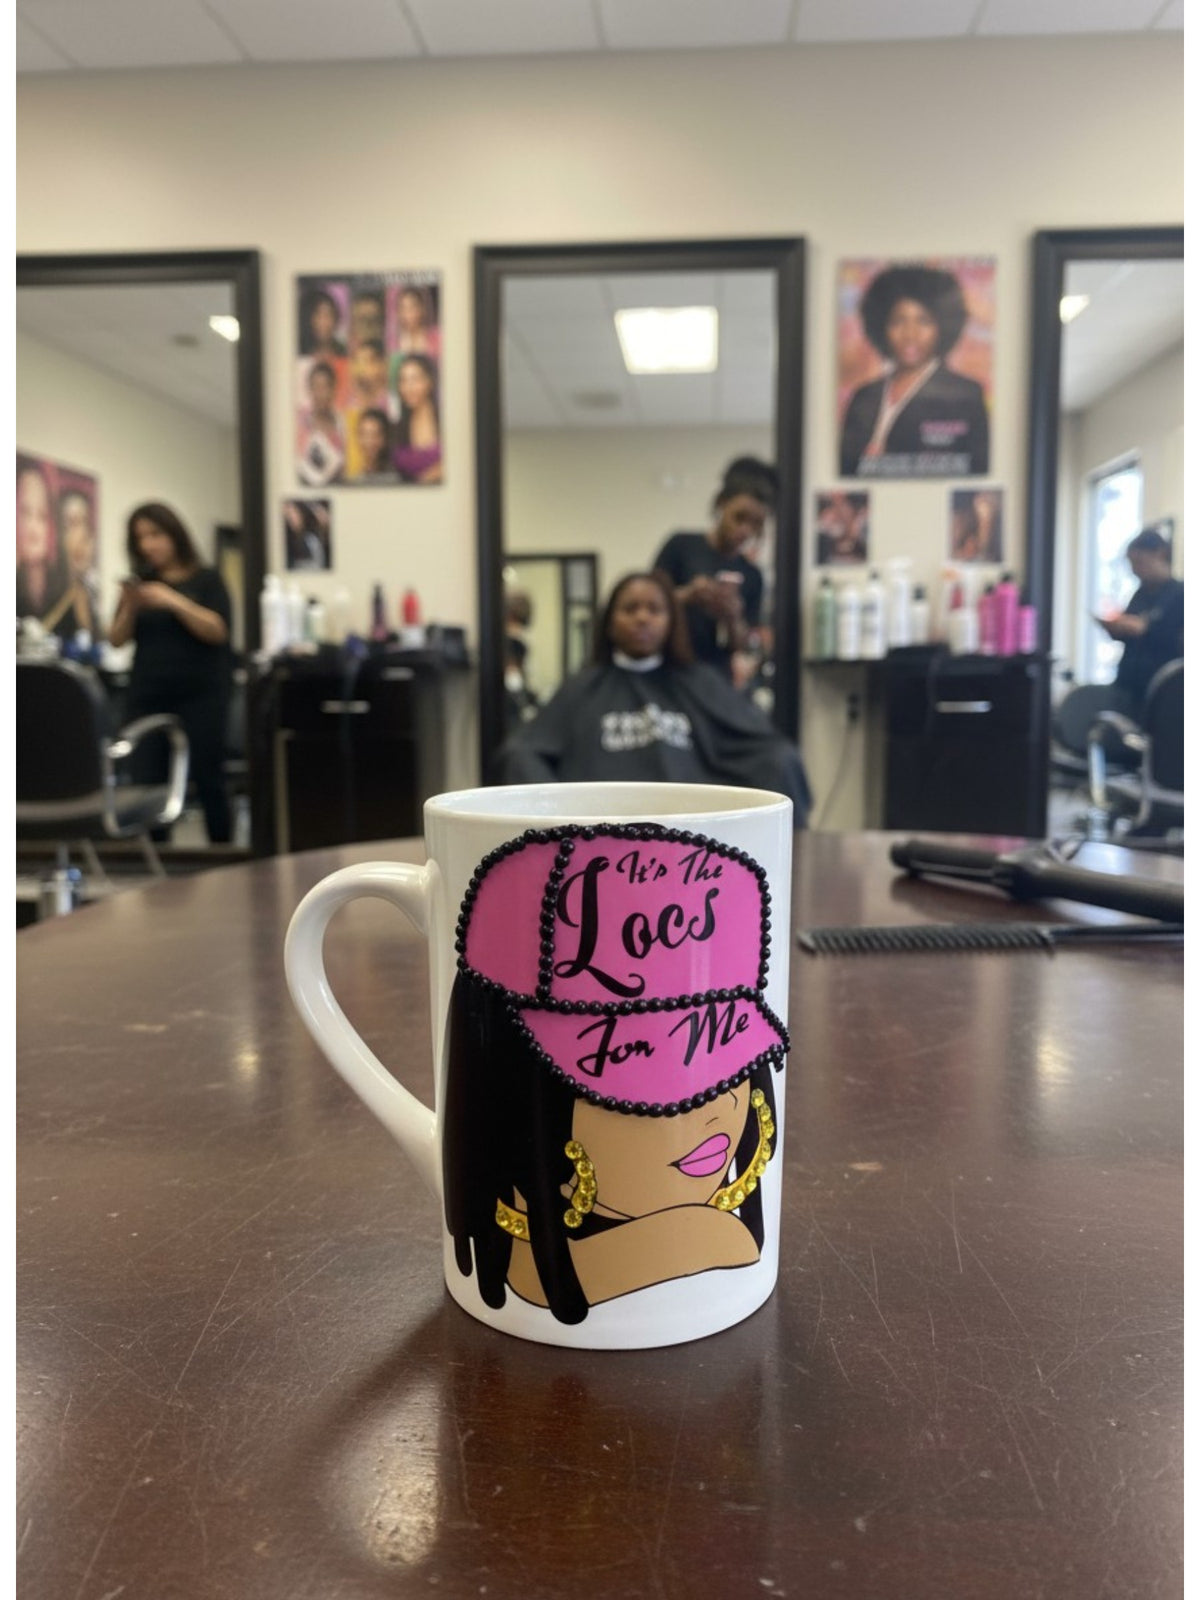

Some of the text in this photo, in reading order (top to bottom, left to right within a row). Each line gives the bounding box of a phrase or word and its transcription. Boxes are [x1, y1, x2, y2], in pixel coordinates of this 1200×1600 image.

[616, 848, 723, 885] It's The
[554, 856, 719, 997] Locs
[576, 1001, 750, 1077] For Me
